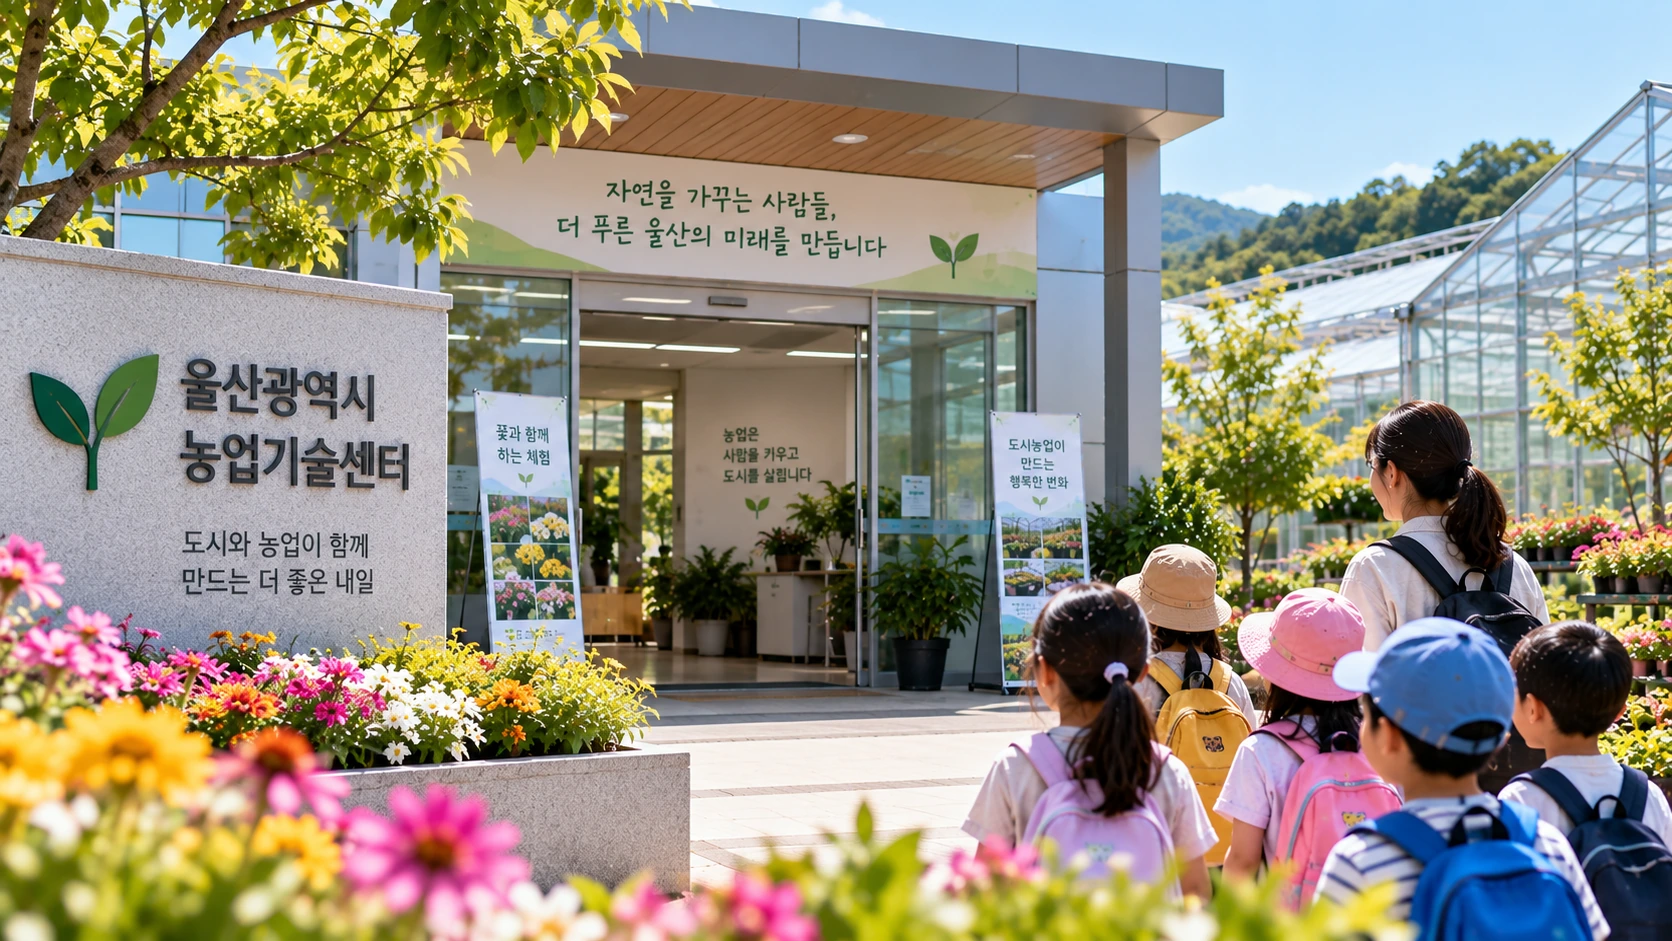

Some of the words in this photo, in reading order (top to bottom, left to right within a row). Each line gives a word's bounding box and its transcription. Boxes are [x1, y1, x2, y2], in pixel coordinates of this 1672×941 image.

[606, 179, 676, 210] 자연을
[687, 185, 752, 213] 가꾸는
[763, 191, 836, 221] 사람들,
[557, 215, 579, 238] 더
[592, 215, 634, 244] 푸른
[645, 217, 711, 248] 울산의
[725, 226, 790, 256] 미래를
[801, 230, 887, 259] 만듭니다
[180, 358, 375, 422] 울산광역시
[496, 424, 521, 442] 꽃과
[497, 446, 522, 464] 하는
[763, 446, 800, 462] 키우고
[1008, 438, 1065, 453] 도시농업이
[180, 430, 410, 491] 농업기술센터
[1020, 457, 1055, 471] 만드는
[722, 468, 760, 484] 도시를
[182, 530, 251, 558] 도시와
[258, 531, 321, 559] 농업이
[329, 532, 369, 559] 함께
[182, 568, 251, 595] 만드는
[259, 568, 279, 595] 더
[336, 568, 374, 595] 내일
